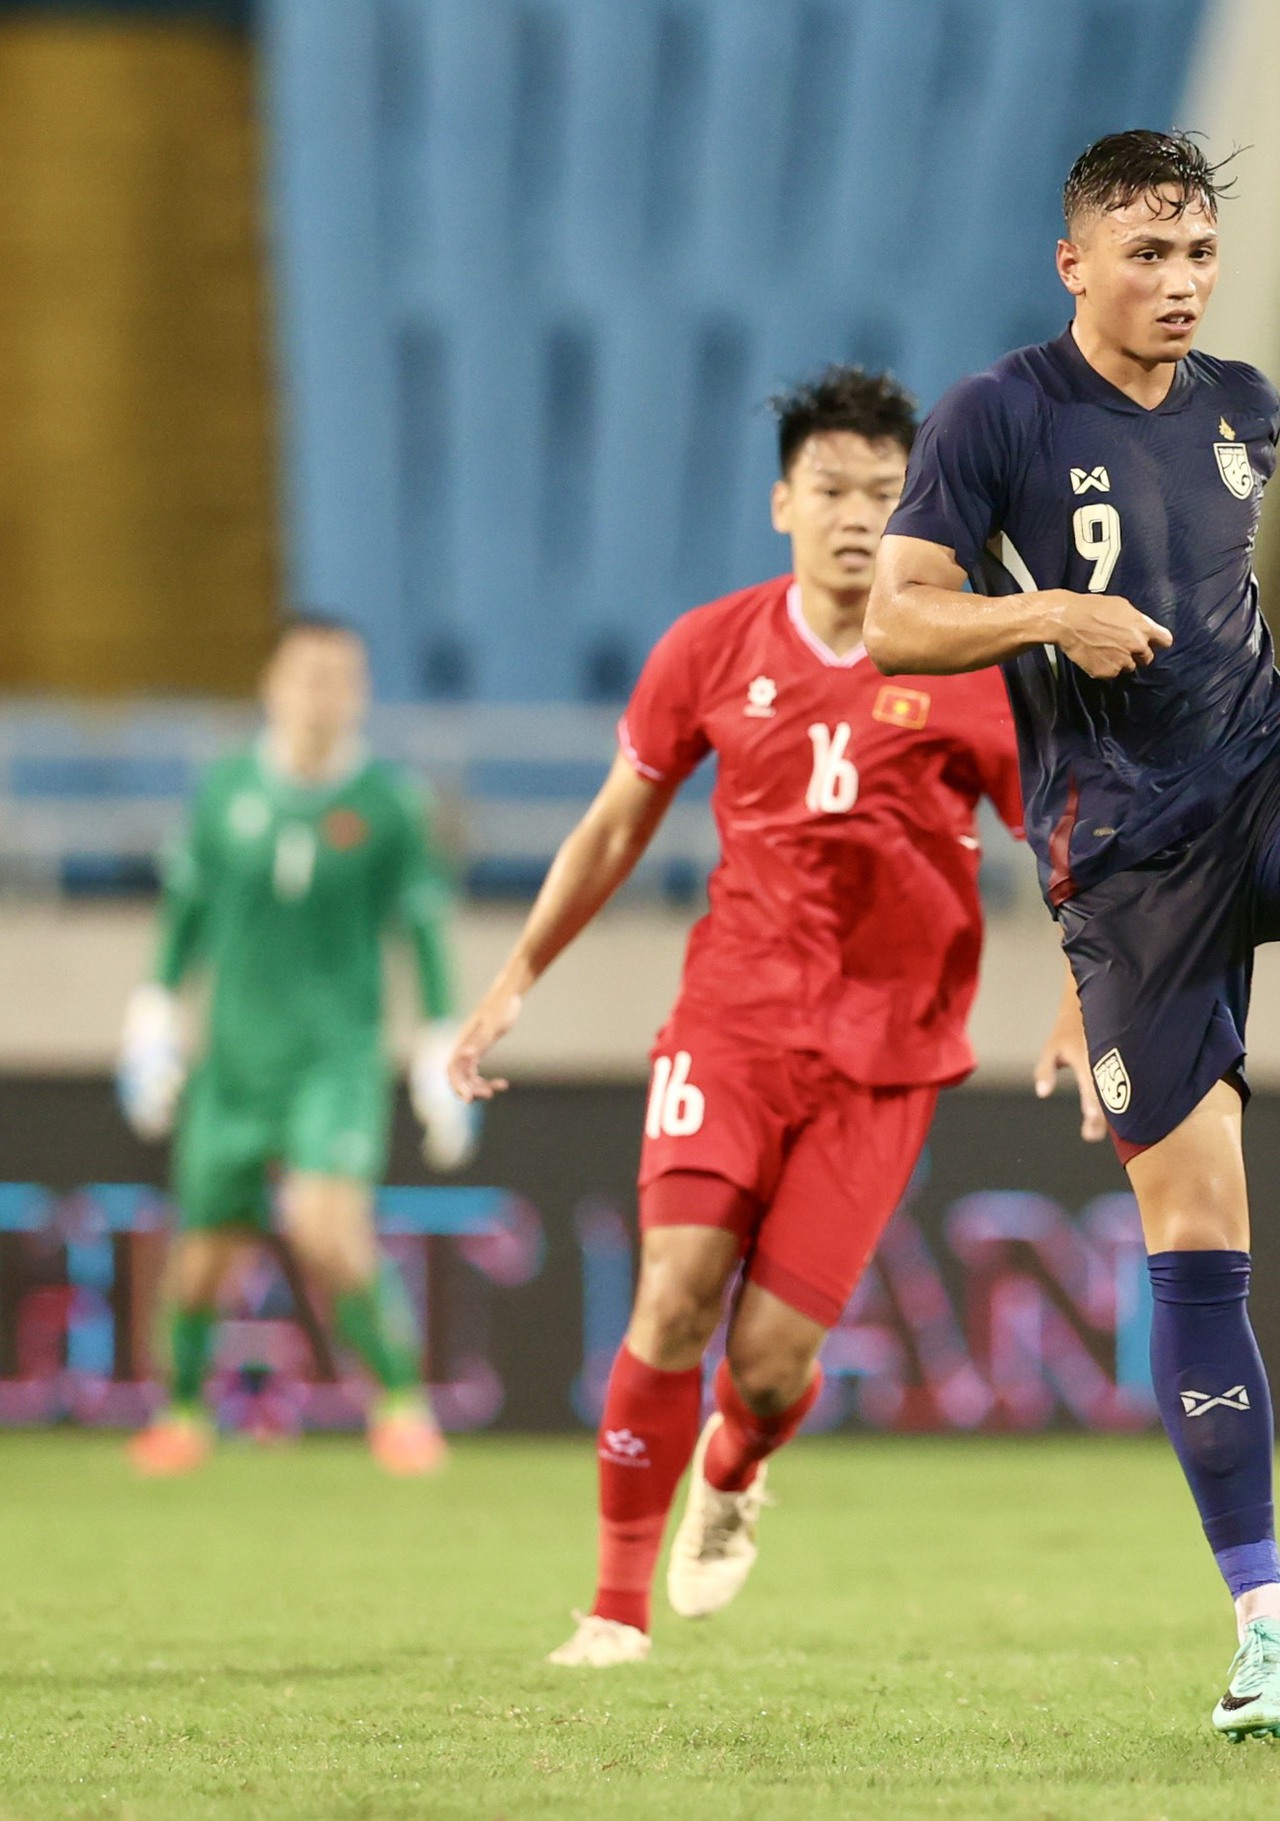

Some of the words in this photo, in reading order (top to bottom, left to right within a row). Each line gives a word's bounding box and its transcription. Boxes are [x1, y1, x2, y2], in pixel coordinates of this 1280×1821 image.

[1072, 503, 1121, 593] 9
[805, 721, 859, 814] 16
[645, 1050, 706, 1140] 16
